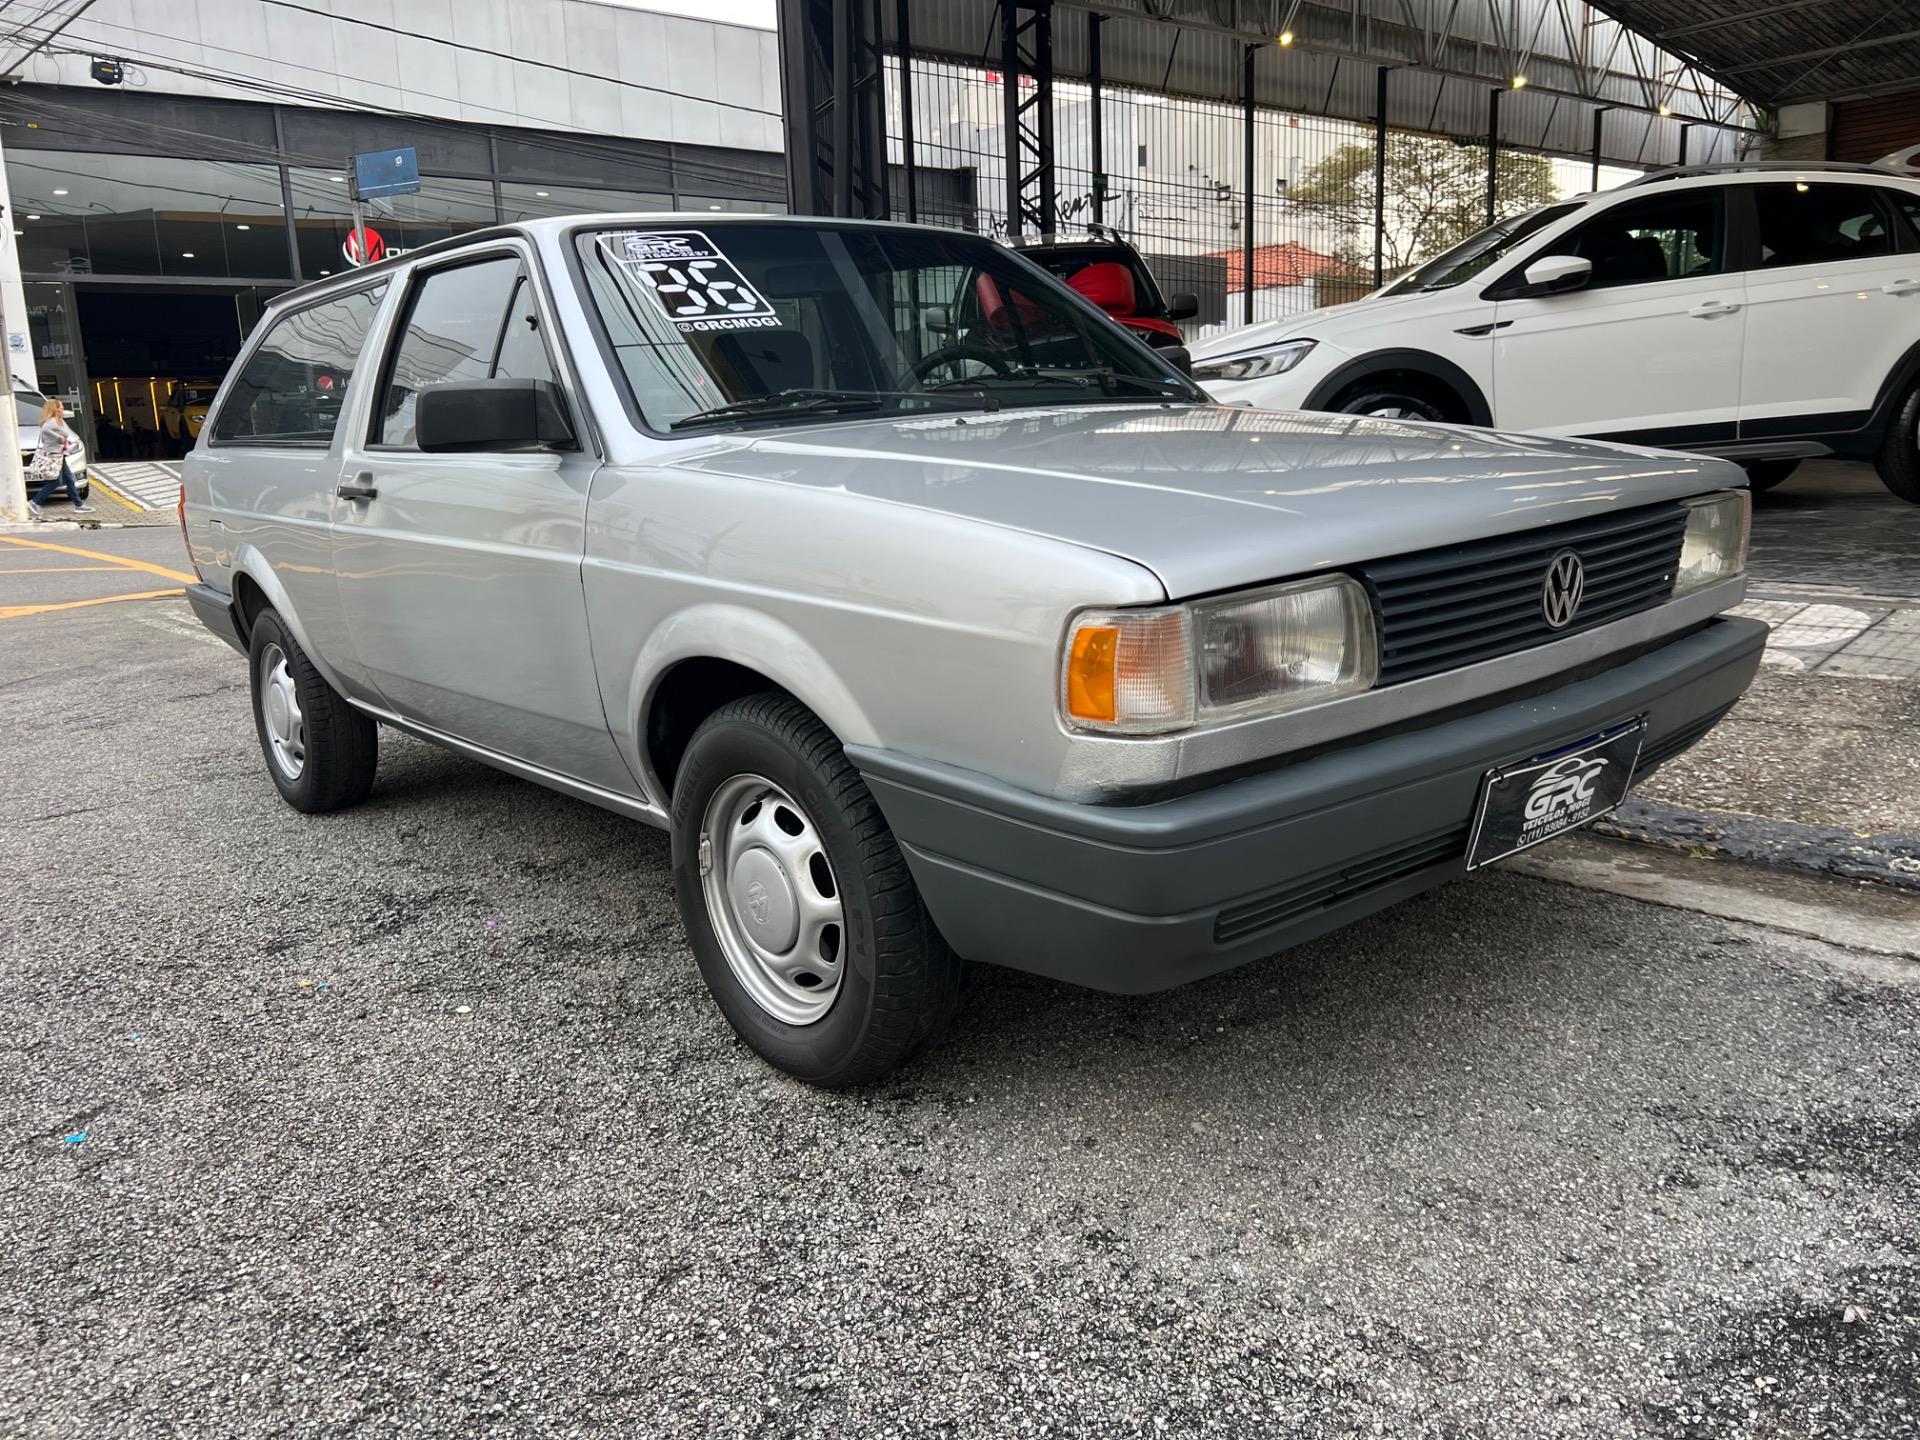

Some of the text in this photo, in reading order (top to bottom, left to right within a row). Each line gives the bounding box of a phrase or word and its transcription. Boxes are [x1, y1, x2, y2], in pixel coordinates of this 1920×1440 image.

[626, 240, 692, 252] GRC
[1524, 766, 1602, 820] GRC
[1522, 797, 1591, 832] VEICULOS MOGI
